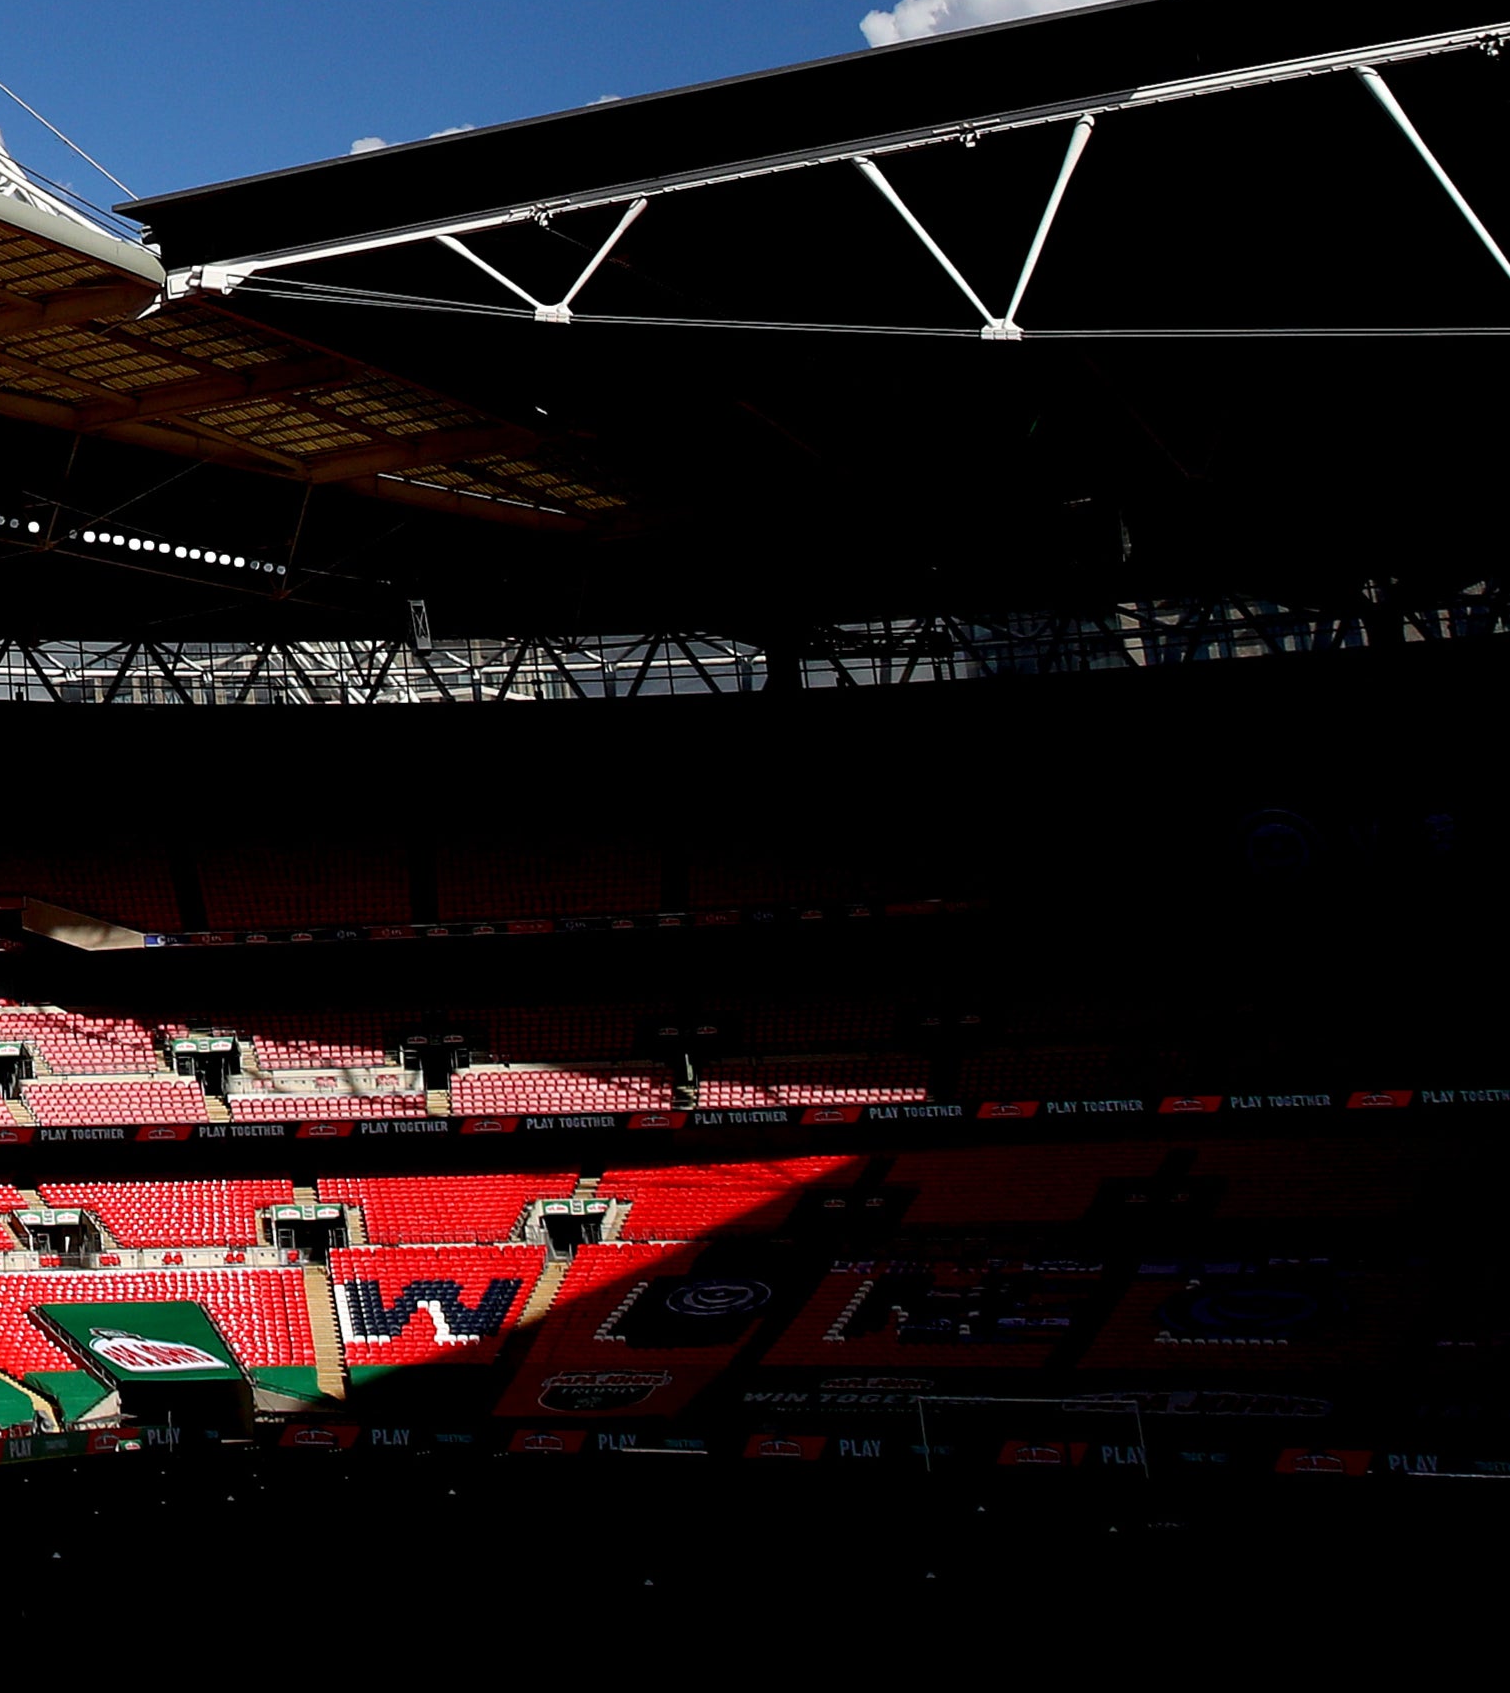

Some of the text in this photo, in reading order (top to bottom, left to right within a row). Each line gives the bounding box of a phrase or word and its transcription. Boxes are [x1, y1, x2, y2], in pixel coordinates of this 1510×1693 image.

[1230, 1094, 1331, 1109] PLAY TOGETHER
[1422, 1091, 1454, 1104] PLAY
[869, 1103, 963, 1119] PLAY TOGETHER
[1046, 1099, 1144, 1114] PLAY TOGETHER
[526, 1114, 616, 1130] PLAY TOGETHER
[694, 1110, 723, 1125] PLAY
[41, 1127, 125, 1141] PLAY TOGETHER
[199, 1123, 285, 1138] PLAY TOGETHER
[361, 1119, 449, 1134] PLAY TOGETHER
[743, 1392, 809, 1402] WIN
[371, 1428, 411, 1448] PLAY
[597, 1433, 638, 1452] PLAY
[838, 1437, 882, 1459] PLAY
[1387, 1452, 1439, 1473] PLAY
